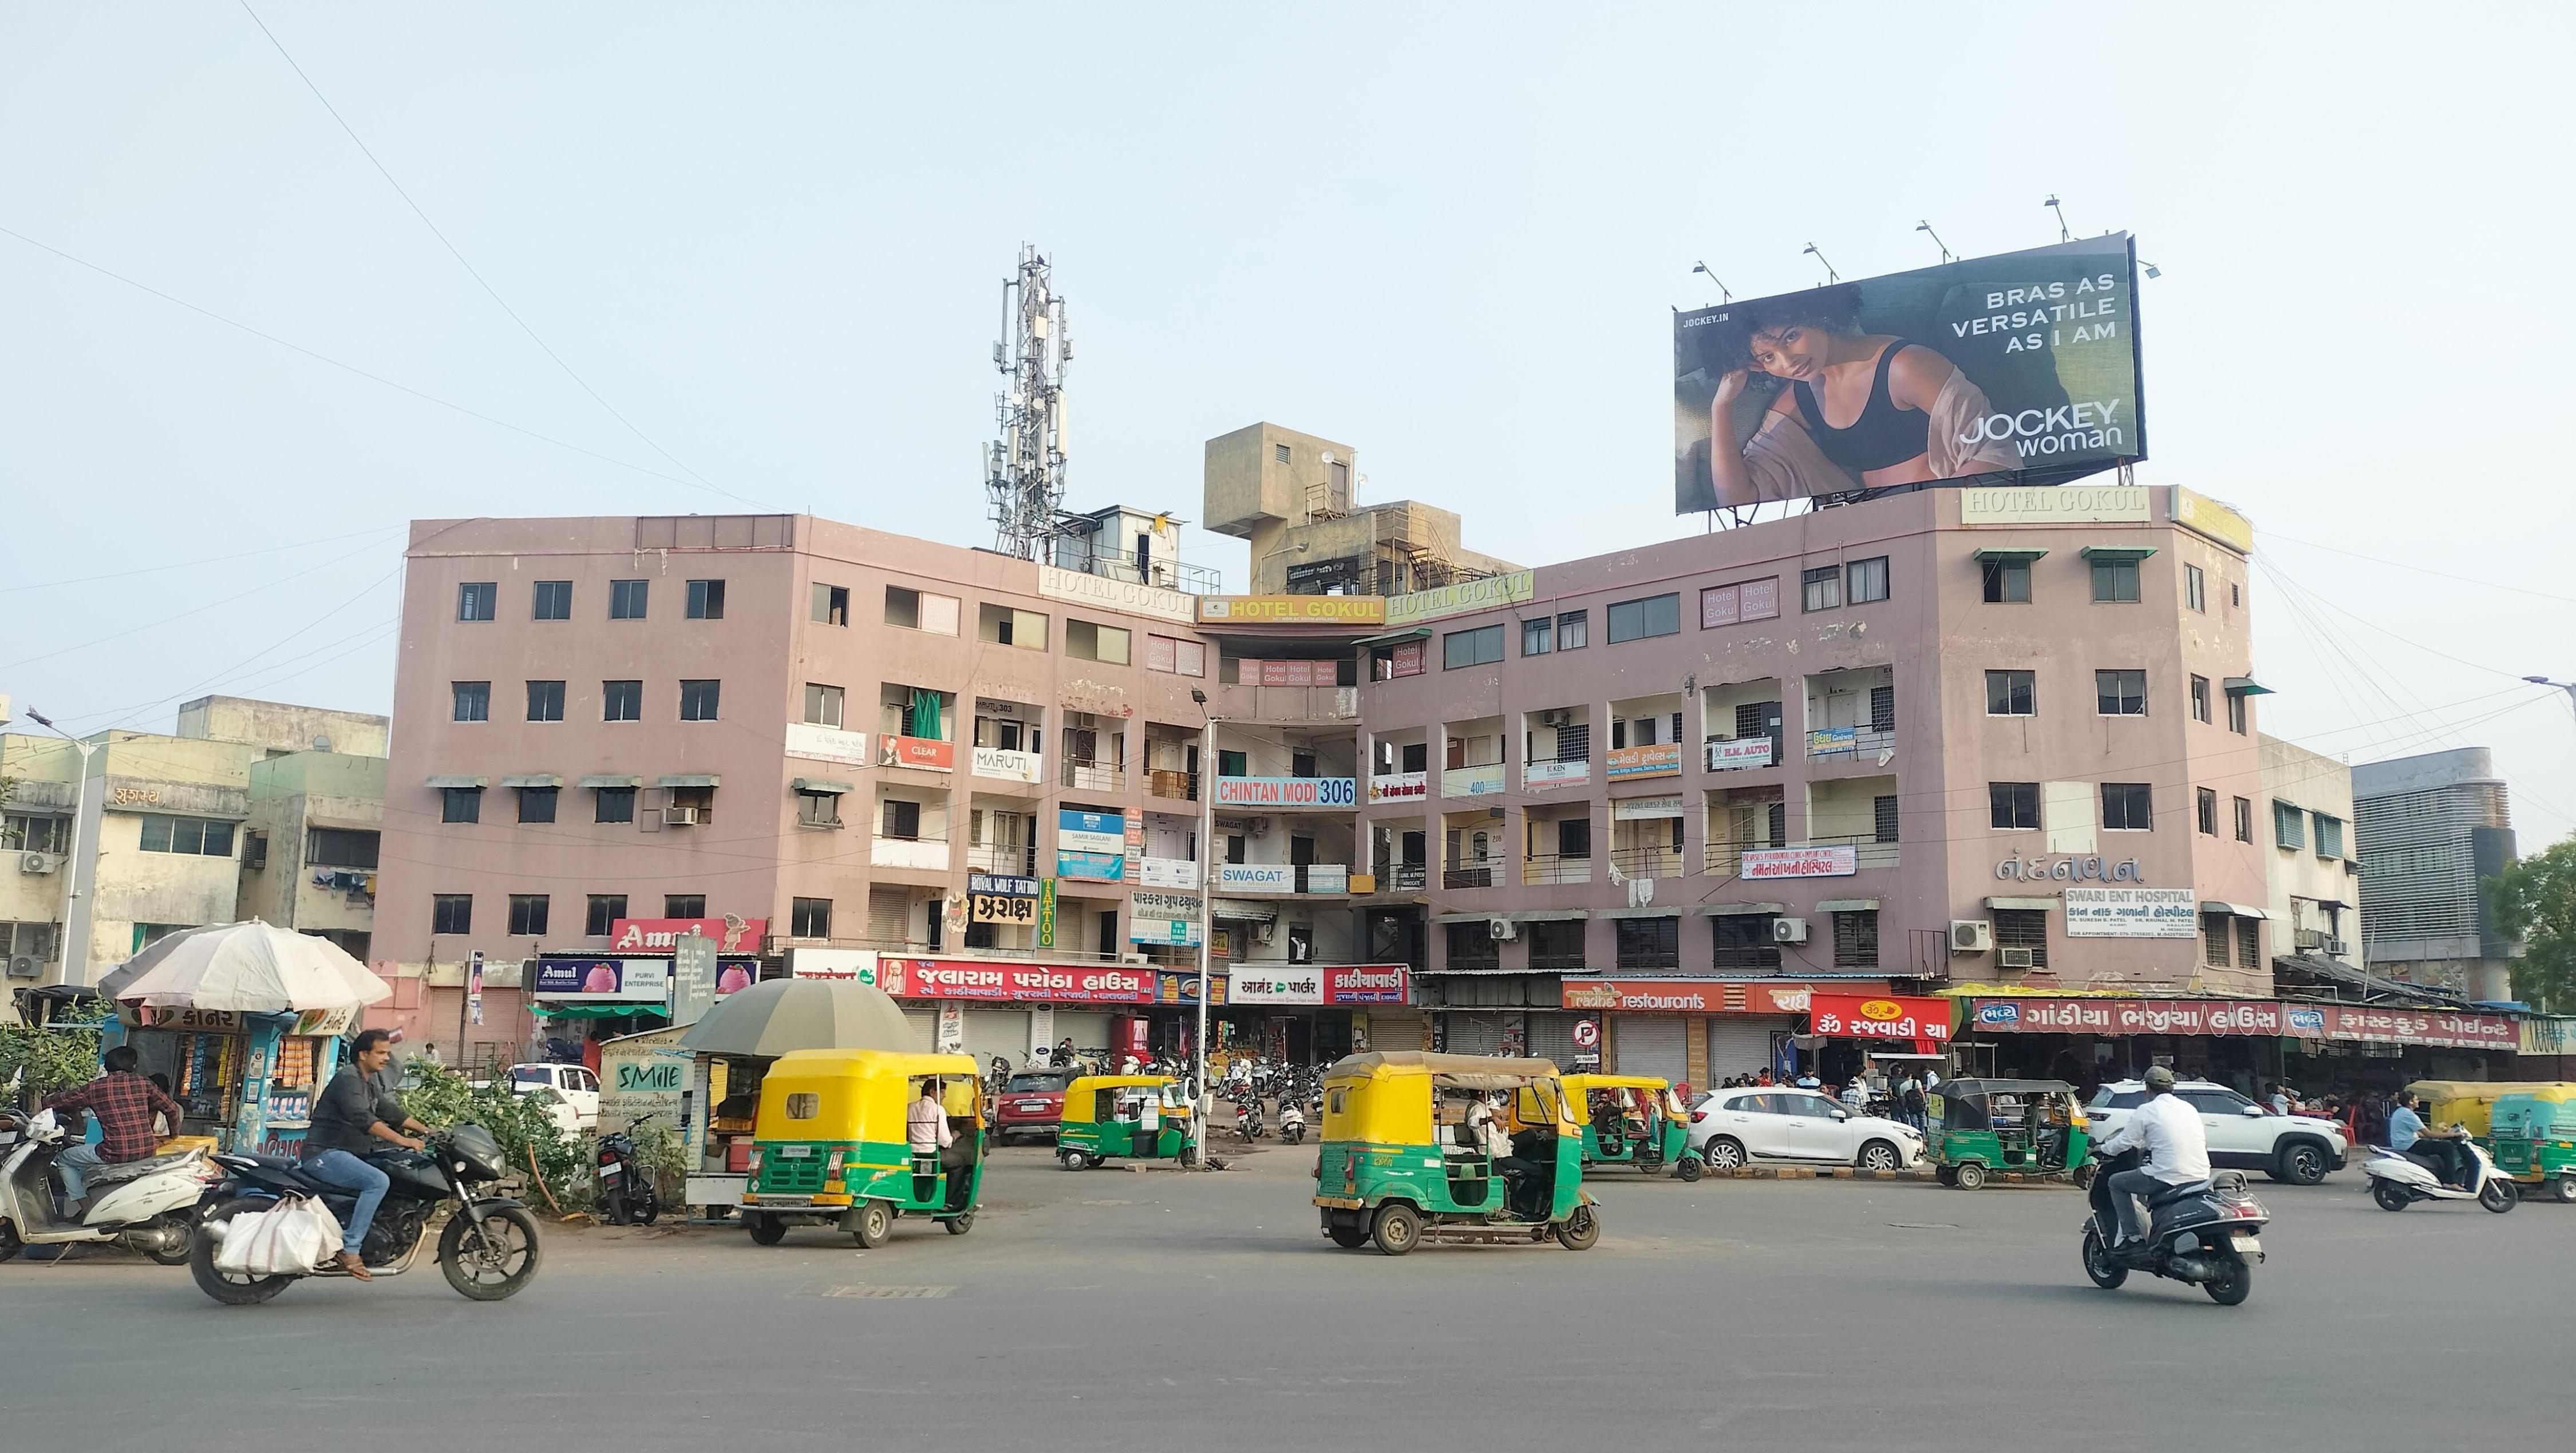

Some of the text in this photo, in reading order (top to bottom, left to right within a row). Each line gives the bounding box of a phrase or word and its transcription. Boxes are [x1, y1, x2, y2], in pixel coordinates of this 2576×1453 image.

[1987, 274, 2115, 309] BRAS AS
[1683, 313, 1729, 328] JOCKEY.IN
[1951, 297, 2116, 338] VERSATILE
[2005, 321, 2116, 354] AS I AM
[1959, 398, 2120, 444] JOCKEY
[2016, 427, 2122, 457] woman
[1969, 490, 2146, 514] HOTEL GOKUL
[1045, 570, 1191, 614] HOTEL GOKUL
[1389, 589, 1453, 617] HOTEL
[1460, 574, 1531, 603] GOKUL
[1708, 590, 1735, 604] Hotel
[1745, 583, 1773, 597] Hotel
[1231, 601, 1380, 617] HOTEL GOKUL
[1706, 604, 1737, 618] Gokul
[1744, 598, 1775, 612] Gokul
[1151, 639, 1173, 651] Hotel
[1397, 645, 1417, 656] Hotel
[1149, 652, 1174, 664] Gokul
[1396, 657, 1419, 669] Gokul
[1264, 674, 1287, 682] Gokul
[1288, 674, 1311, 682] Gokul
[999, 704, 1012, 712] 303
[911, 746, 937, 757] CLEAR
[1619, 749, 1665, 765] મેલડી ટ્રાવેલ્સ
[1744, 745, 1770, 755] AUTO
[977, 752, 1026, 771] MARUTI
[1220, 780, 1353, 804] CHINTAN MODI 306
[1471, 781, 1484, 794] 400
[1215, 820, 1242, 830] SWAGAT
[1996, 847, 2145, 884] નંદનવન
[1223, 870, 1283, 882] SWAGAT
[971, 876, 1038, 895] ROYAL WOLF TATTOO
[1133, 892, 1162, 906] પારકરા
[2067, 890, 2193, 903] SWARI ENT HOSPITAL
[1041, 878, 1054, 945] TATTOO
[2068, 907, 2088, 916] કાન
[2092, 907, 2112, 917] નાક
[2116, 905, 2150, 917] ગળાની
[542, 965, 578, 979] Amul
[916, 969, 1003, 985] જલારામ
[1013, 967, 1073, 989] પરોઠા
[1082, 972, 1140, 991] હાઉસ
[1335, 968, 1402, 988] કાઠીયાવાડી
[943, 985, 1002, 997] કાઠીયાવાડી
[1012, 989, 1051, 1000] ગુજરાતી
[1058, 989, 1091, 1000] પંજાબી
[1242, 978, 1273, 994] આનંદ
[1287, 978, 1316, 994] પાર્લર
[1622, 992, 1706, 1010] restaurants
[2122, 1010, 2198, 1031] ભજીયા
[2210, 1006, 2277, 1028] હાઉસ
[1850, 1017, 1916, 1037] રજવાડી
[1925, 1024, 1947, 1038] ચા
